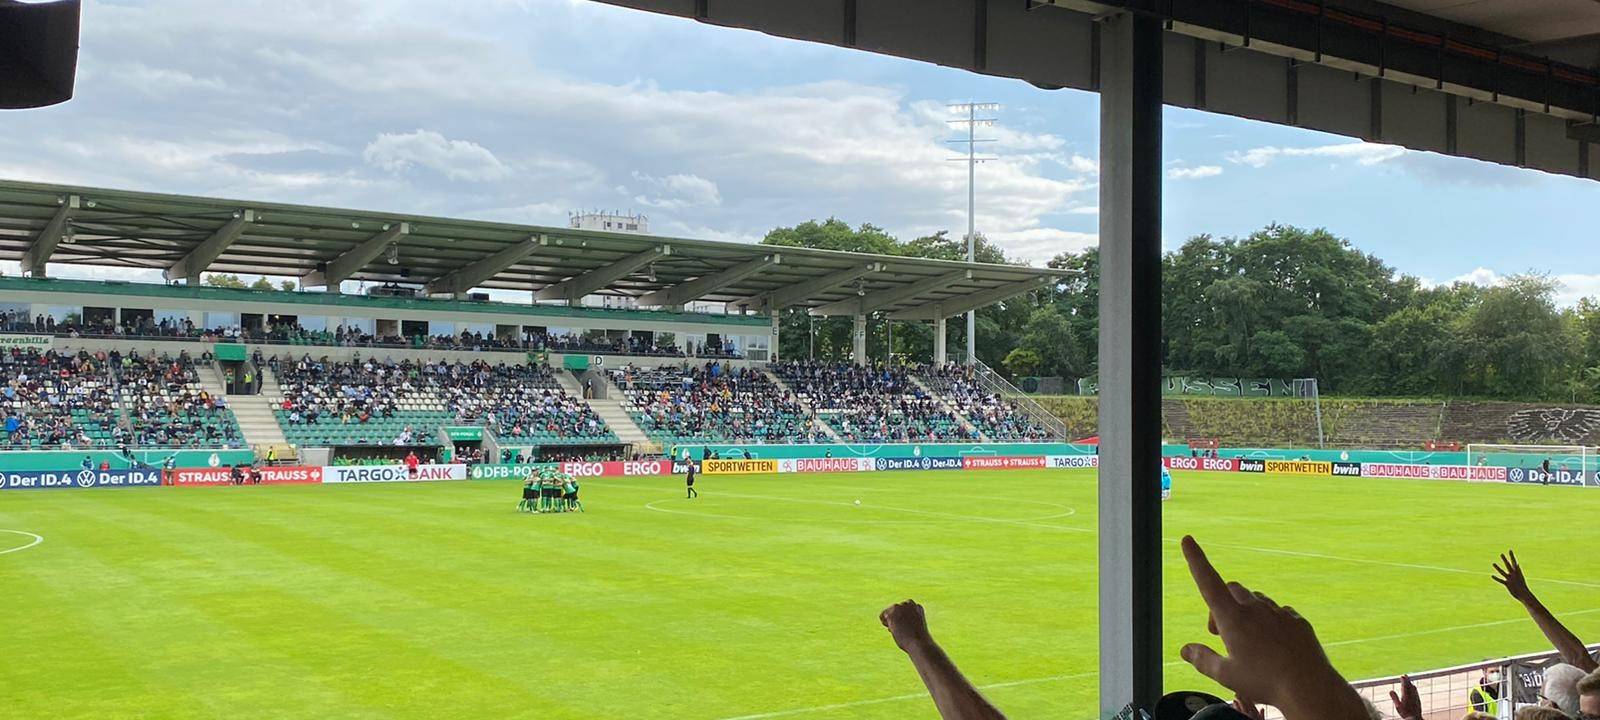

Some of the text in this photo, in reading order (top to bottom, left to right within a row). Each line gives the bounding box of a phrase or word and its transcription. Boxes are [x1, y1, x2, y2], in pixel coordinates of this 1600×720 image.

[595, 356, 603, 365] D
[672, 462, 700, 474] bwn
[708, 461, 773, 472] SPORTWETTEN
[797, 459, 859, 470] BAUHAUS
[889, 460, 902, 468] Der
[904, 459, 920, 468] ID.4
[972, 459, 1002, 467] STRAUSS
[1010, 458, 1039, 466] STRAUSS
[1170, 458, 1198, 469] ERGO
[1203, 459, 1232, 470] ERGO
[1239, 460, 1263, 472] bwin
[1267, 461, 1329, 474] SPORTWETTEN
[484, 466, 539, 478] DFB-PO
[564, 463, 604, 476] ERGO
[624, 462, 660, 475] ERGO
[1333, 463, 1359, 475] bwin
[1370, 464, 1429, 477] BAUHAUS
[1441, 466, 1506, 480] BAUHAUS
[10, 473, 72, 486] Der ID.4
[100, 473, 126, 484] Der
[129, 472, 158, 484] ID.4
[260, 470, 308, 481] TRAUSS
